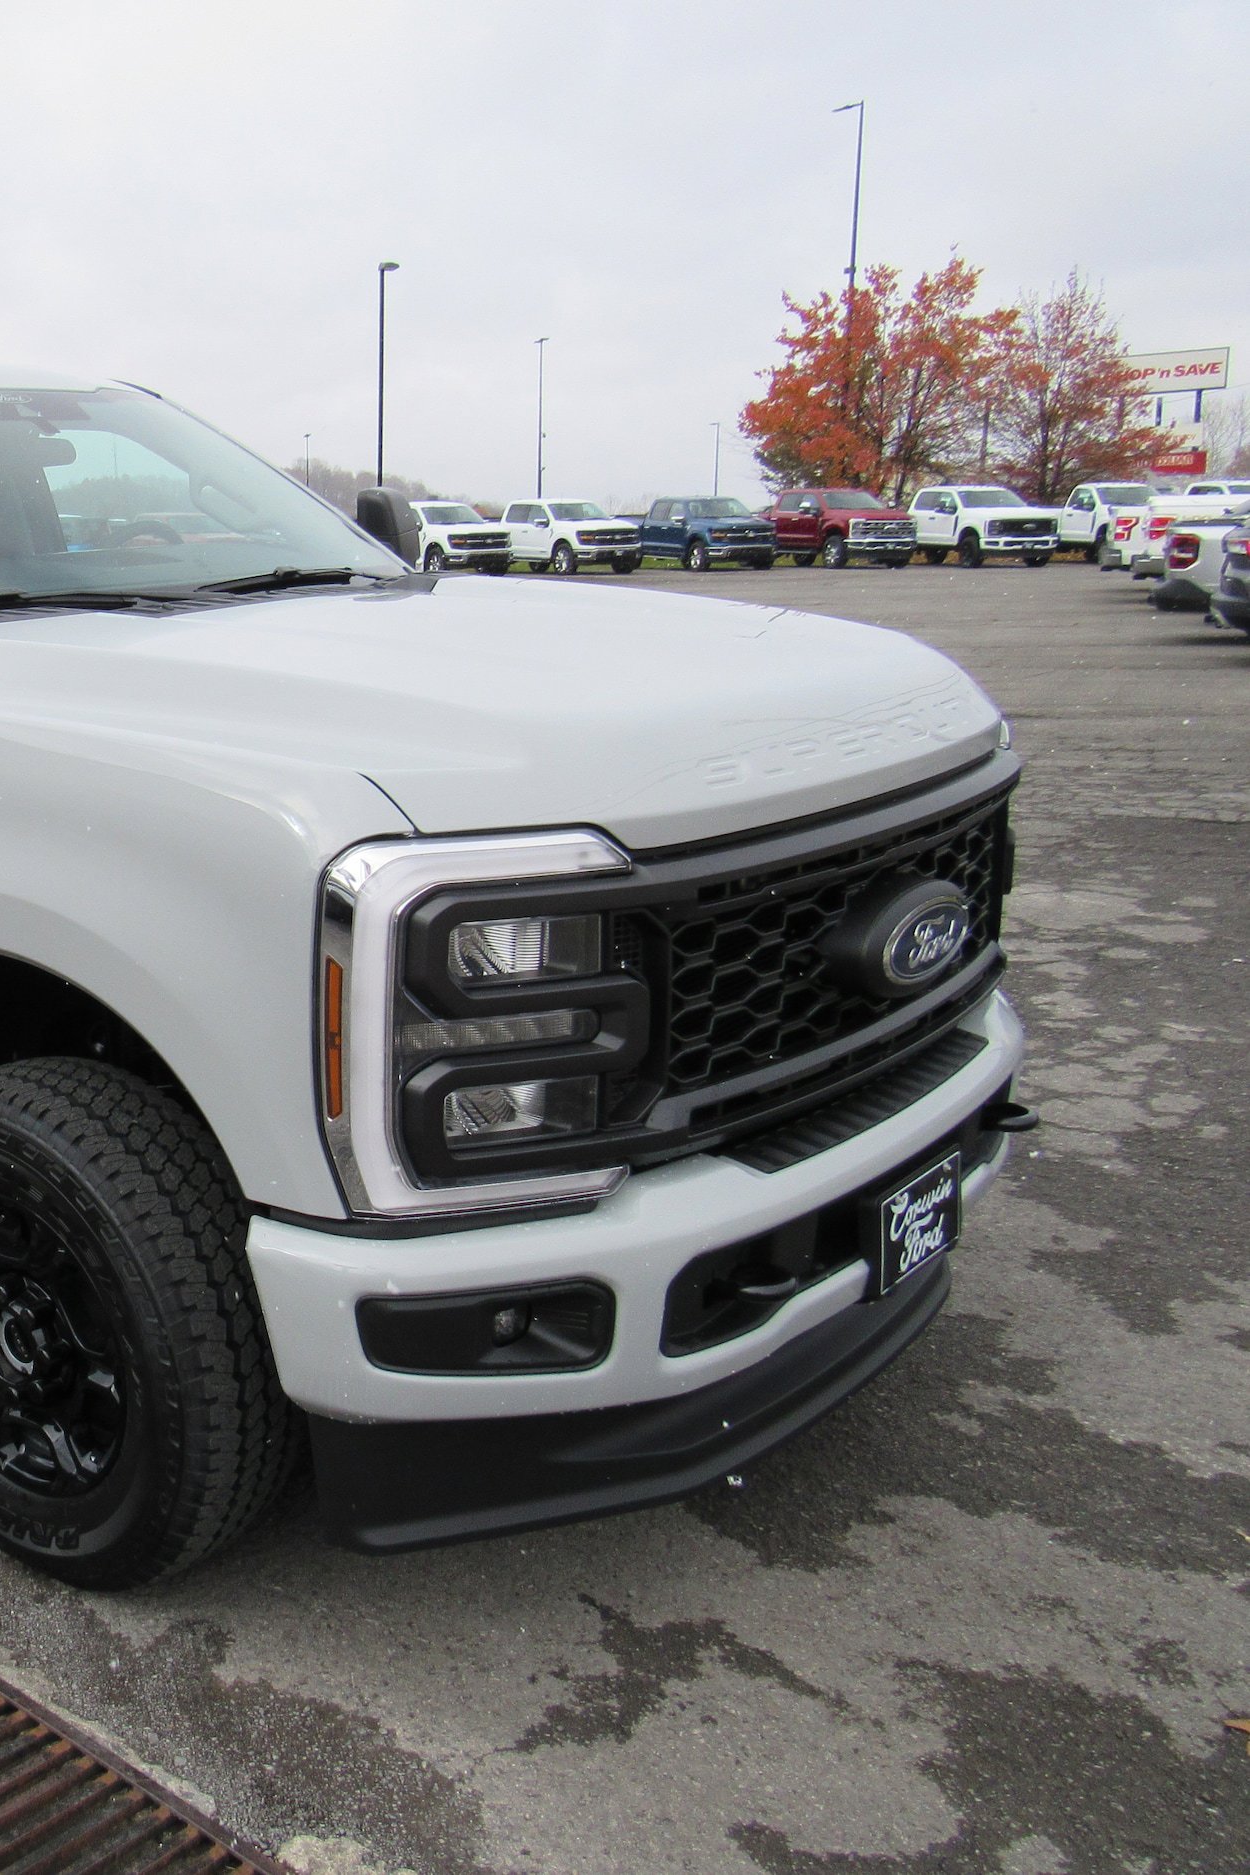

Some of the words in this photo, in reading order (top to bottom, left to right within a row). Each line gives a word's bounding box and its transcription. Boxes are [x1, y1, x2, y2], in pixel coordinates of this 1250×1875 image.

[1173, 361, 1223, 378] SAVE
[908, 913, 956, 969] Ford
[889, 1177, 952, 1242] Corwin
[899, 1211, 946, 1273] Ford
